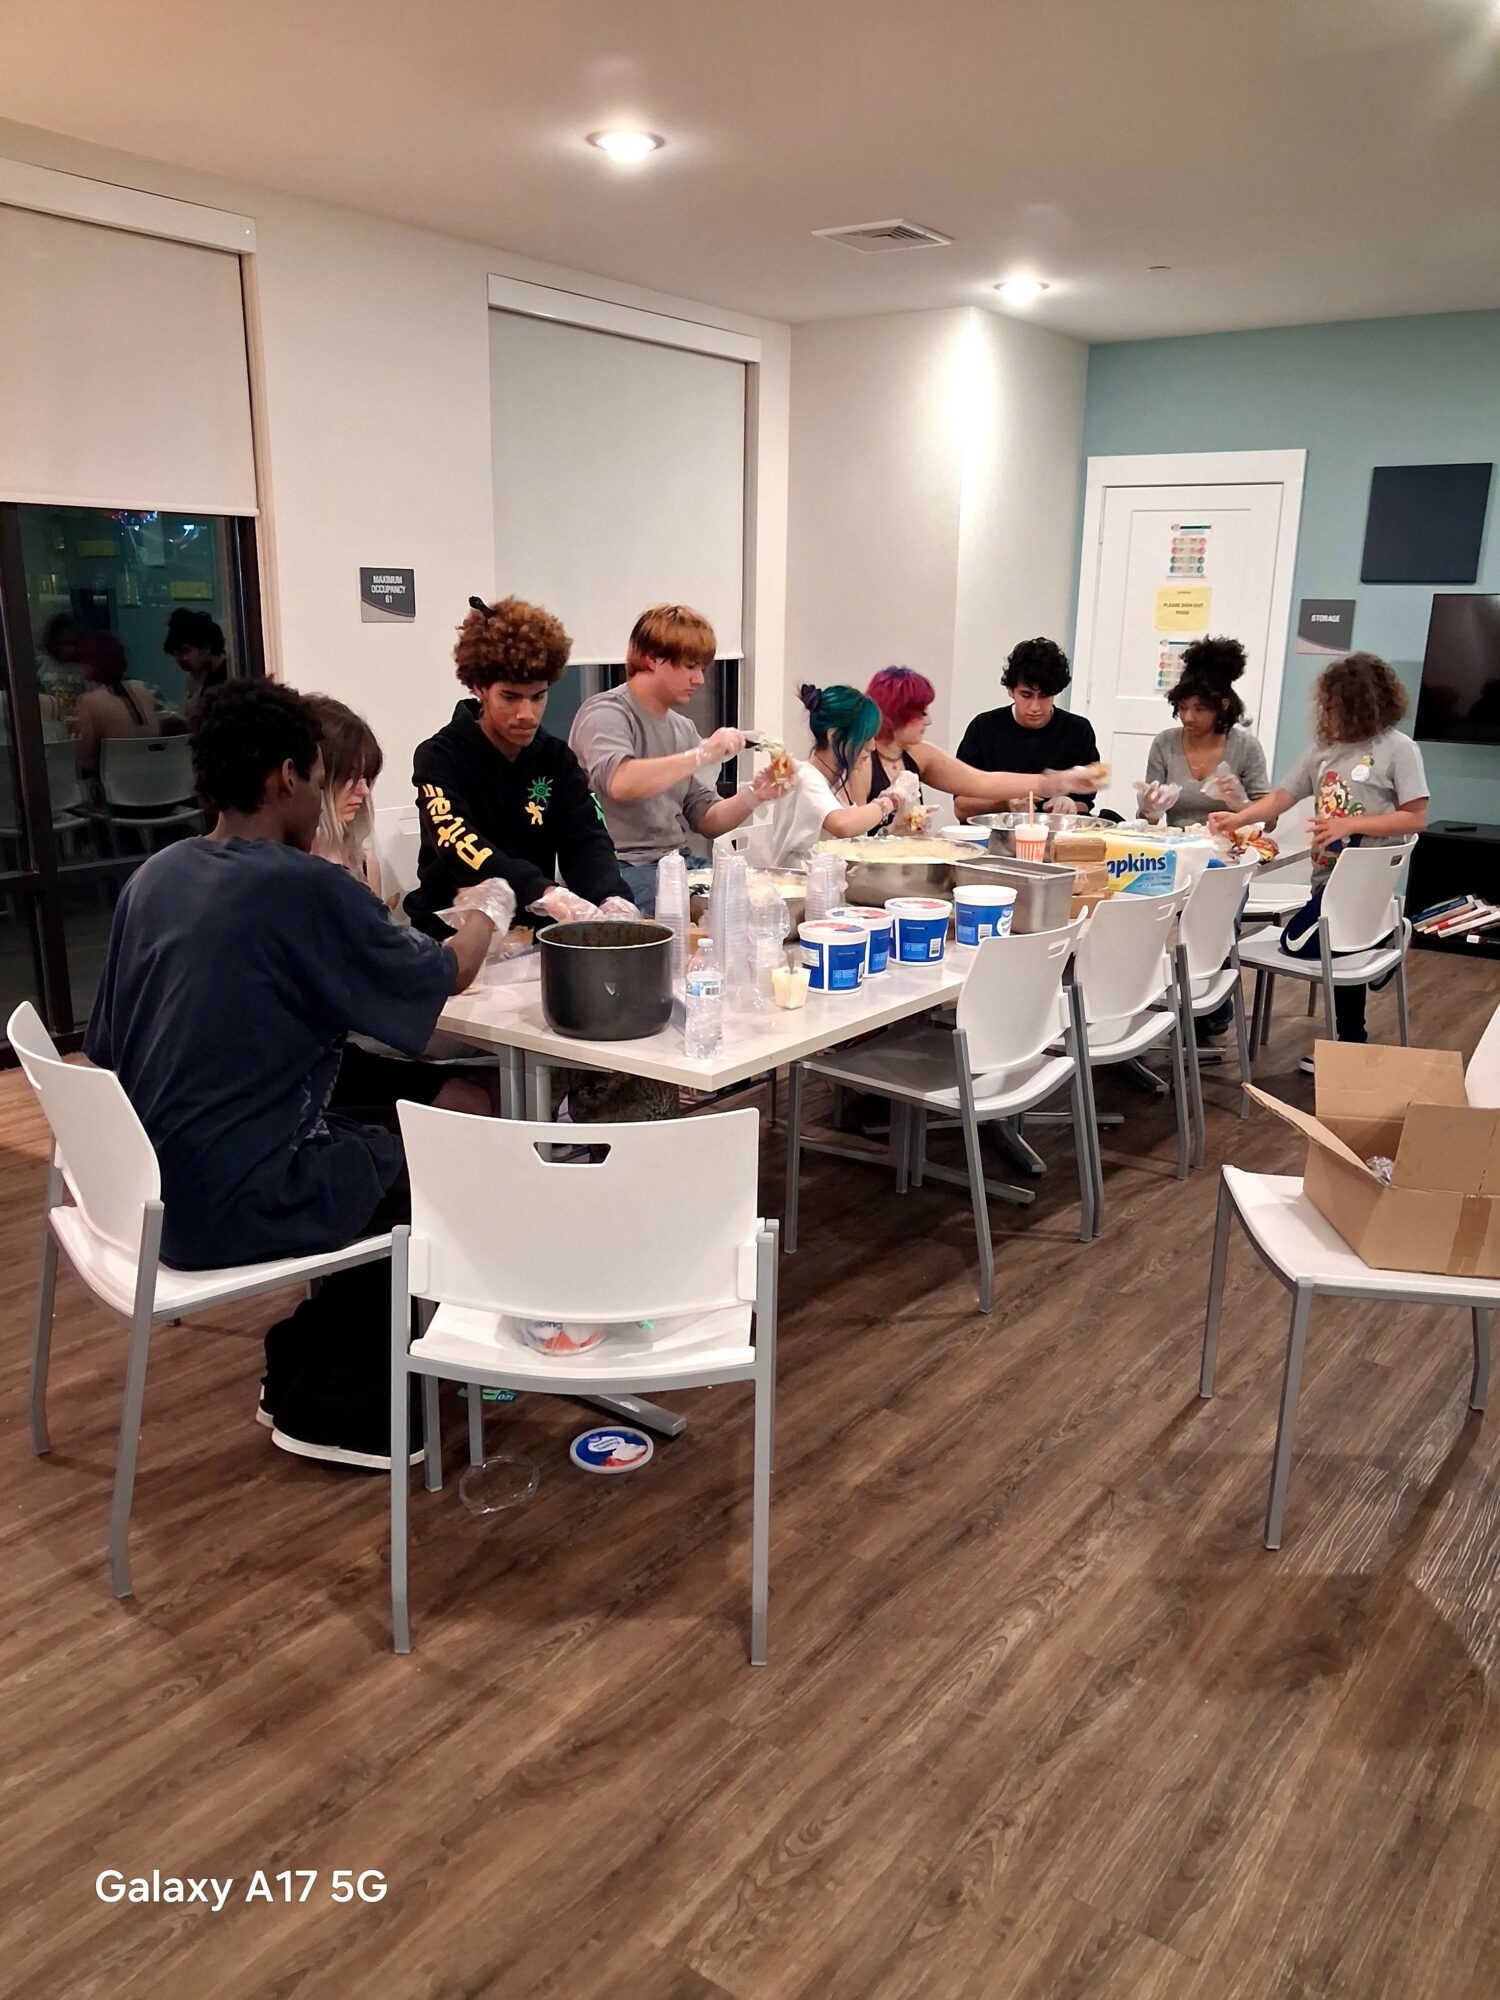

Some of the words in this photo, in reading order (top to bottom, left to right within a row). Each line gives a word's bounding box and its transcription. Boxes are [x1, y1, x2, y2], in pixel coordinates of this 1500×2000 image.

[373, 575, 403, 584] MAXIMUM
[371, 584, 406, 594] OCCUPANCY
[385, 594, 393, 603] 61
[1311, 614, 1341, 623] STORAGE
[1106, 852, 1166, 878] apkins
